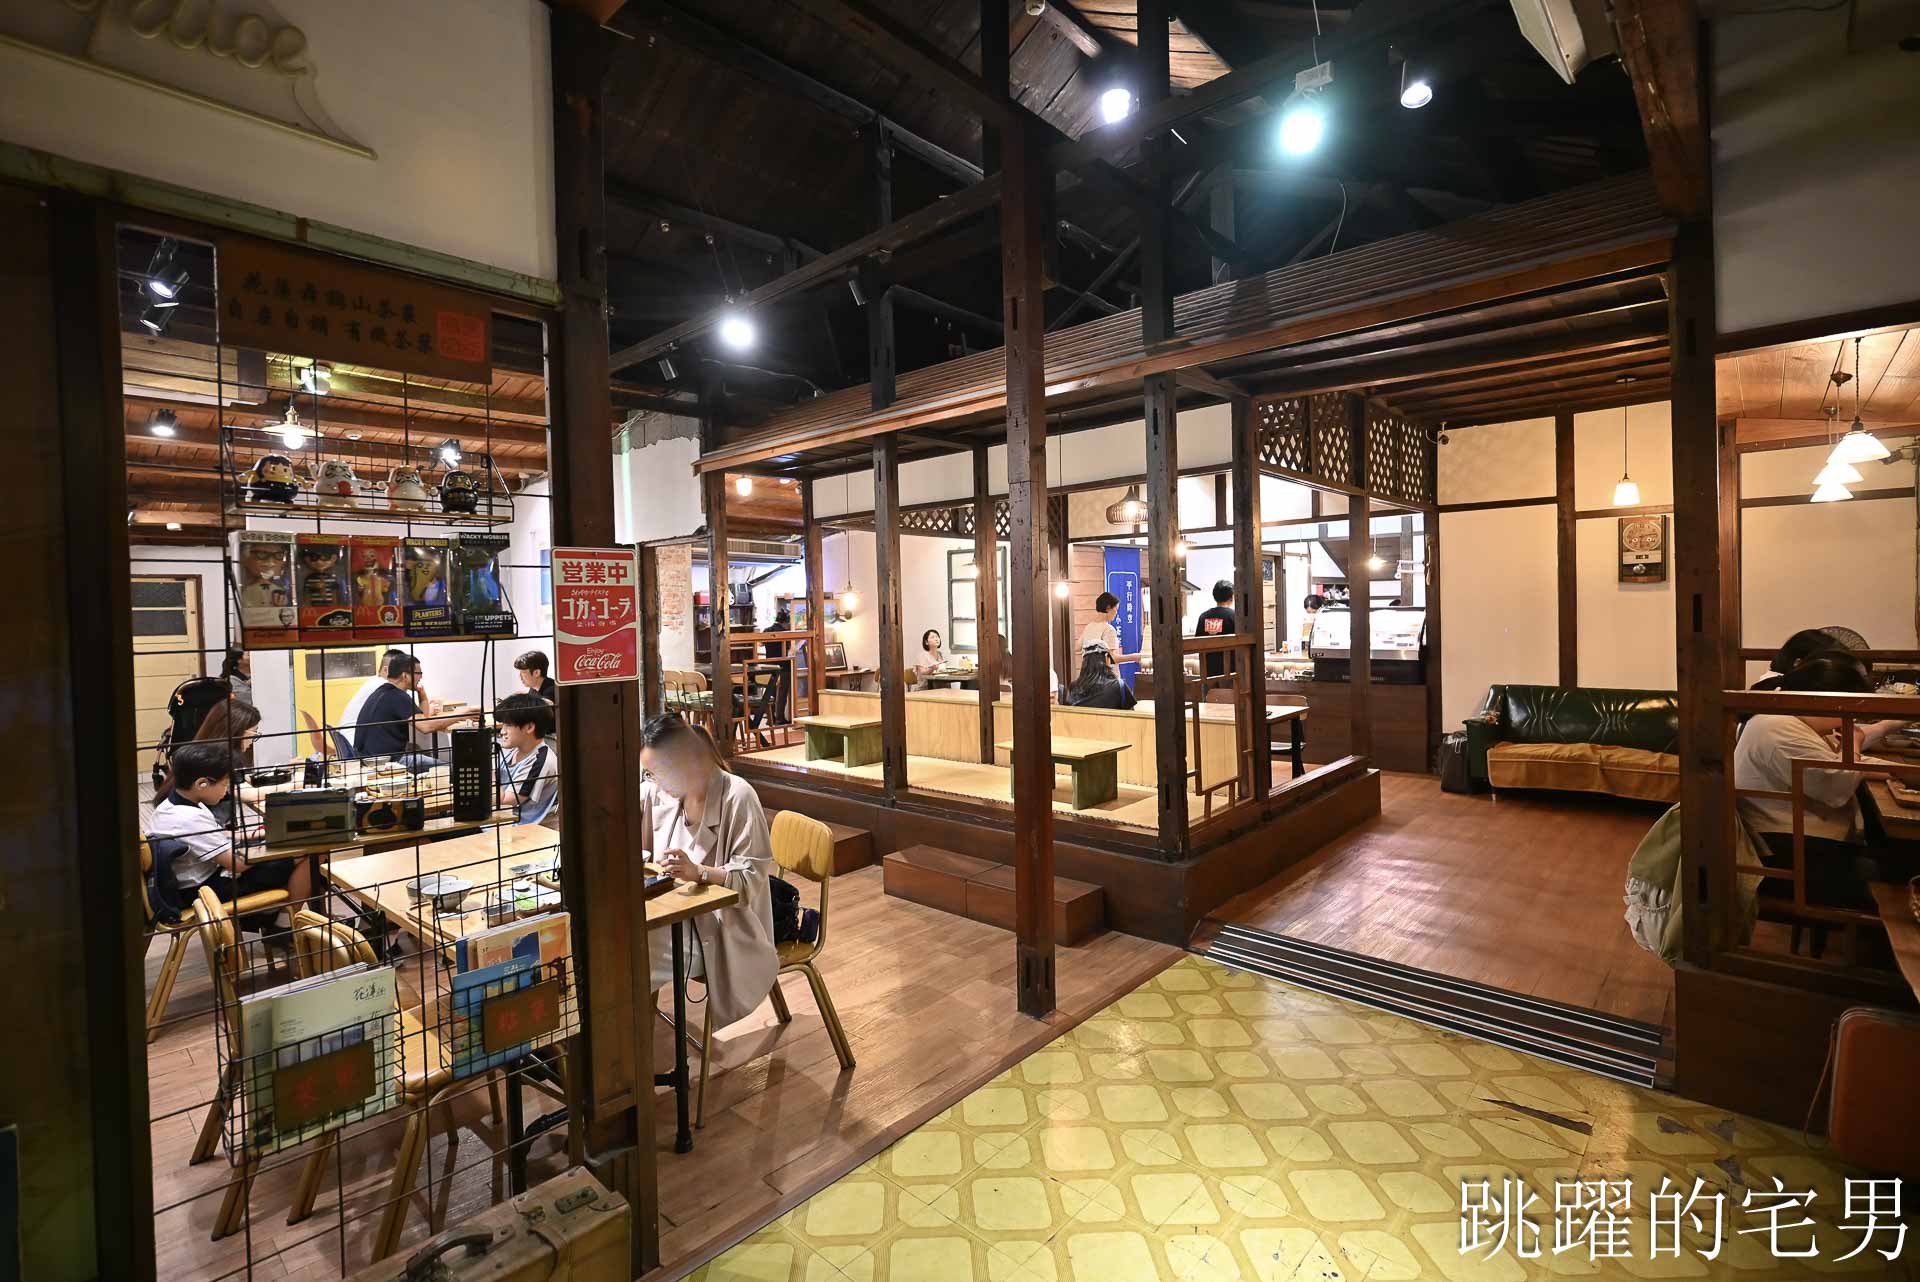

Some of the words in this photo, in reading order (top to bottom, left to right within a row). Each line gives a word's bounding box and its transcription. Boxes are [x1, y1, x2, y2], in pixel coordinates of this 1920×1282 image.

[562, 561, 628, 584] 営業中
[586, 647, 604, 657] Enjoy
